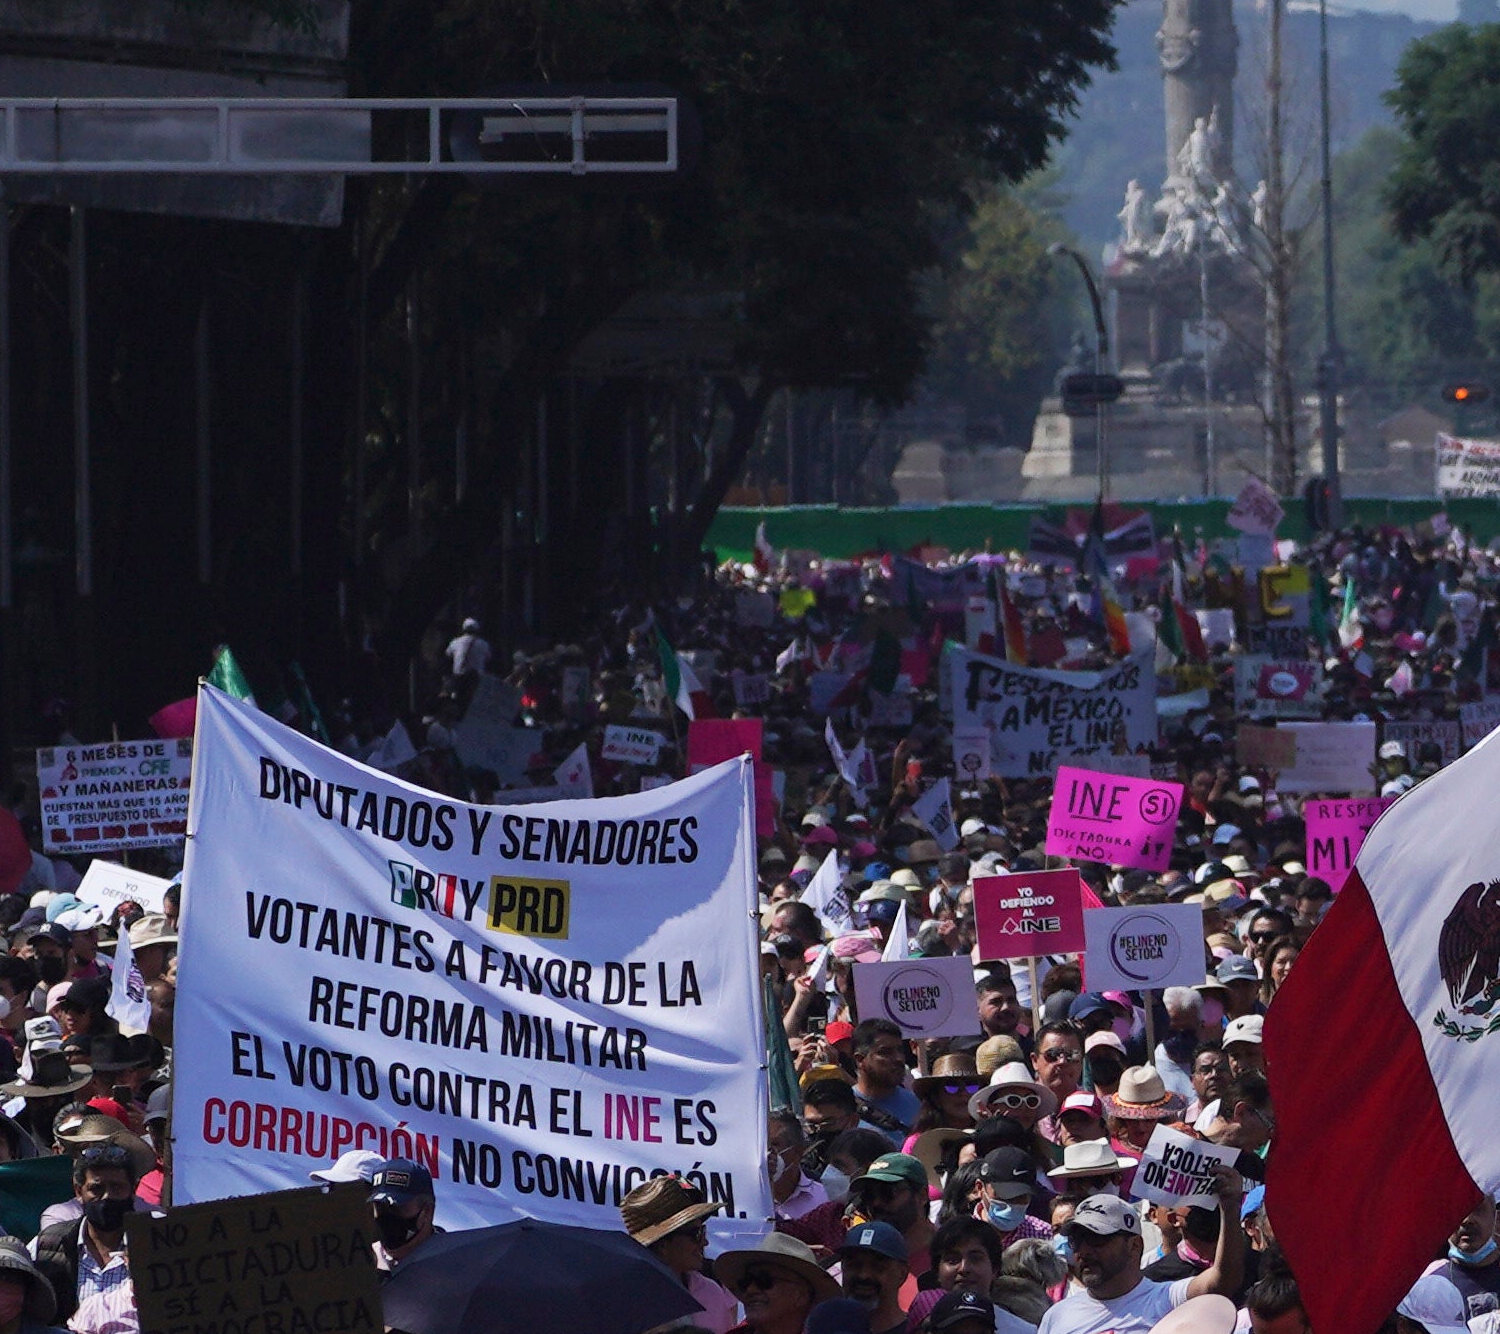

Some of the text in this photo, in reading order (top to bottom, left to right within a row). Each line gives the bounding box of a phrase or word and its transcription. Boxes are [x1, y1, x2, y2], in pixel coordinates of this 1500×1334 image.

[1000, 711, 1020, 731] A
[1046, 722, 1075, 747] EL
[66, 744, 165, 763] 6 MESES DE
[138, 759, 170, 776] CFE
[58, 776, 179, 797] Y MAÑANERAS
[44, 800, 94, 814] CUESTAN
[123, 795, 145, 808] QUE
[150, 795, 161, 805] 15
[1068, 779, 1168, 821] INE SI
[47, 808, 161, 826] DE PRESUPUESTO DEL
[258, 755, 699, 867] DIPUTADOS Y SENADORES
[1053, 827, 1131, 848] DICTADURA
[125, 881, 139, 893] YO
[388, 859, 565, 934] PRI Y PRD
[1017, 886, 1035, 898] YO
[1000, 894, 1055, 909] DEFIENDO
[1022, 908, 1036, 918] AL
[1021, 915, 1061, 933] INE
[246, 891, 703, 1008] VOTANTES A FAVOR DE LA
[1119, 932, 1168, 949] #ELINENO
[1125, 946, 1164, 961] SETOCA
[892, 985, 941, 1002] #ELINENO
[899, 997, 938, 1013] SETOCA
[308, 974, 649, 1072] REFORMA MILITAR
[230, 1031, 719, 1148] EL VOTO CONTRA EL INE ES
[452, 1137, 503, 1188] NO
[1142, 1161, 1216, 1197] ELINENO
[153, 1210, 281, 1249] NO A LA
[146, 1230, 368, 1294] DICTADURA
[224, 1292, 242, 1312] A
[260, 1281, 294, 1306] LA
